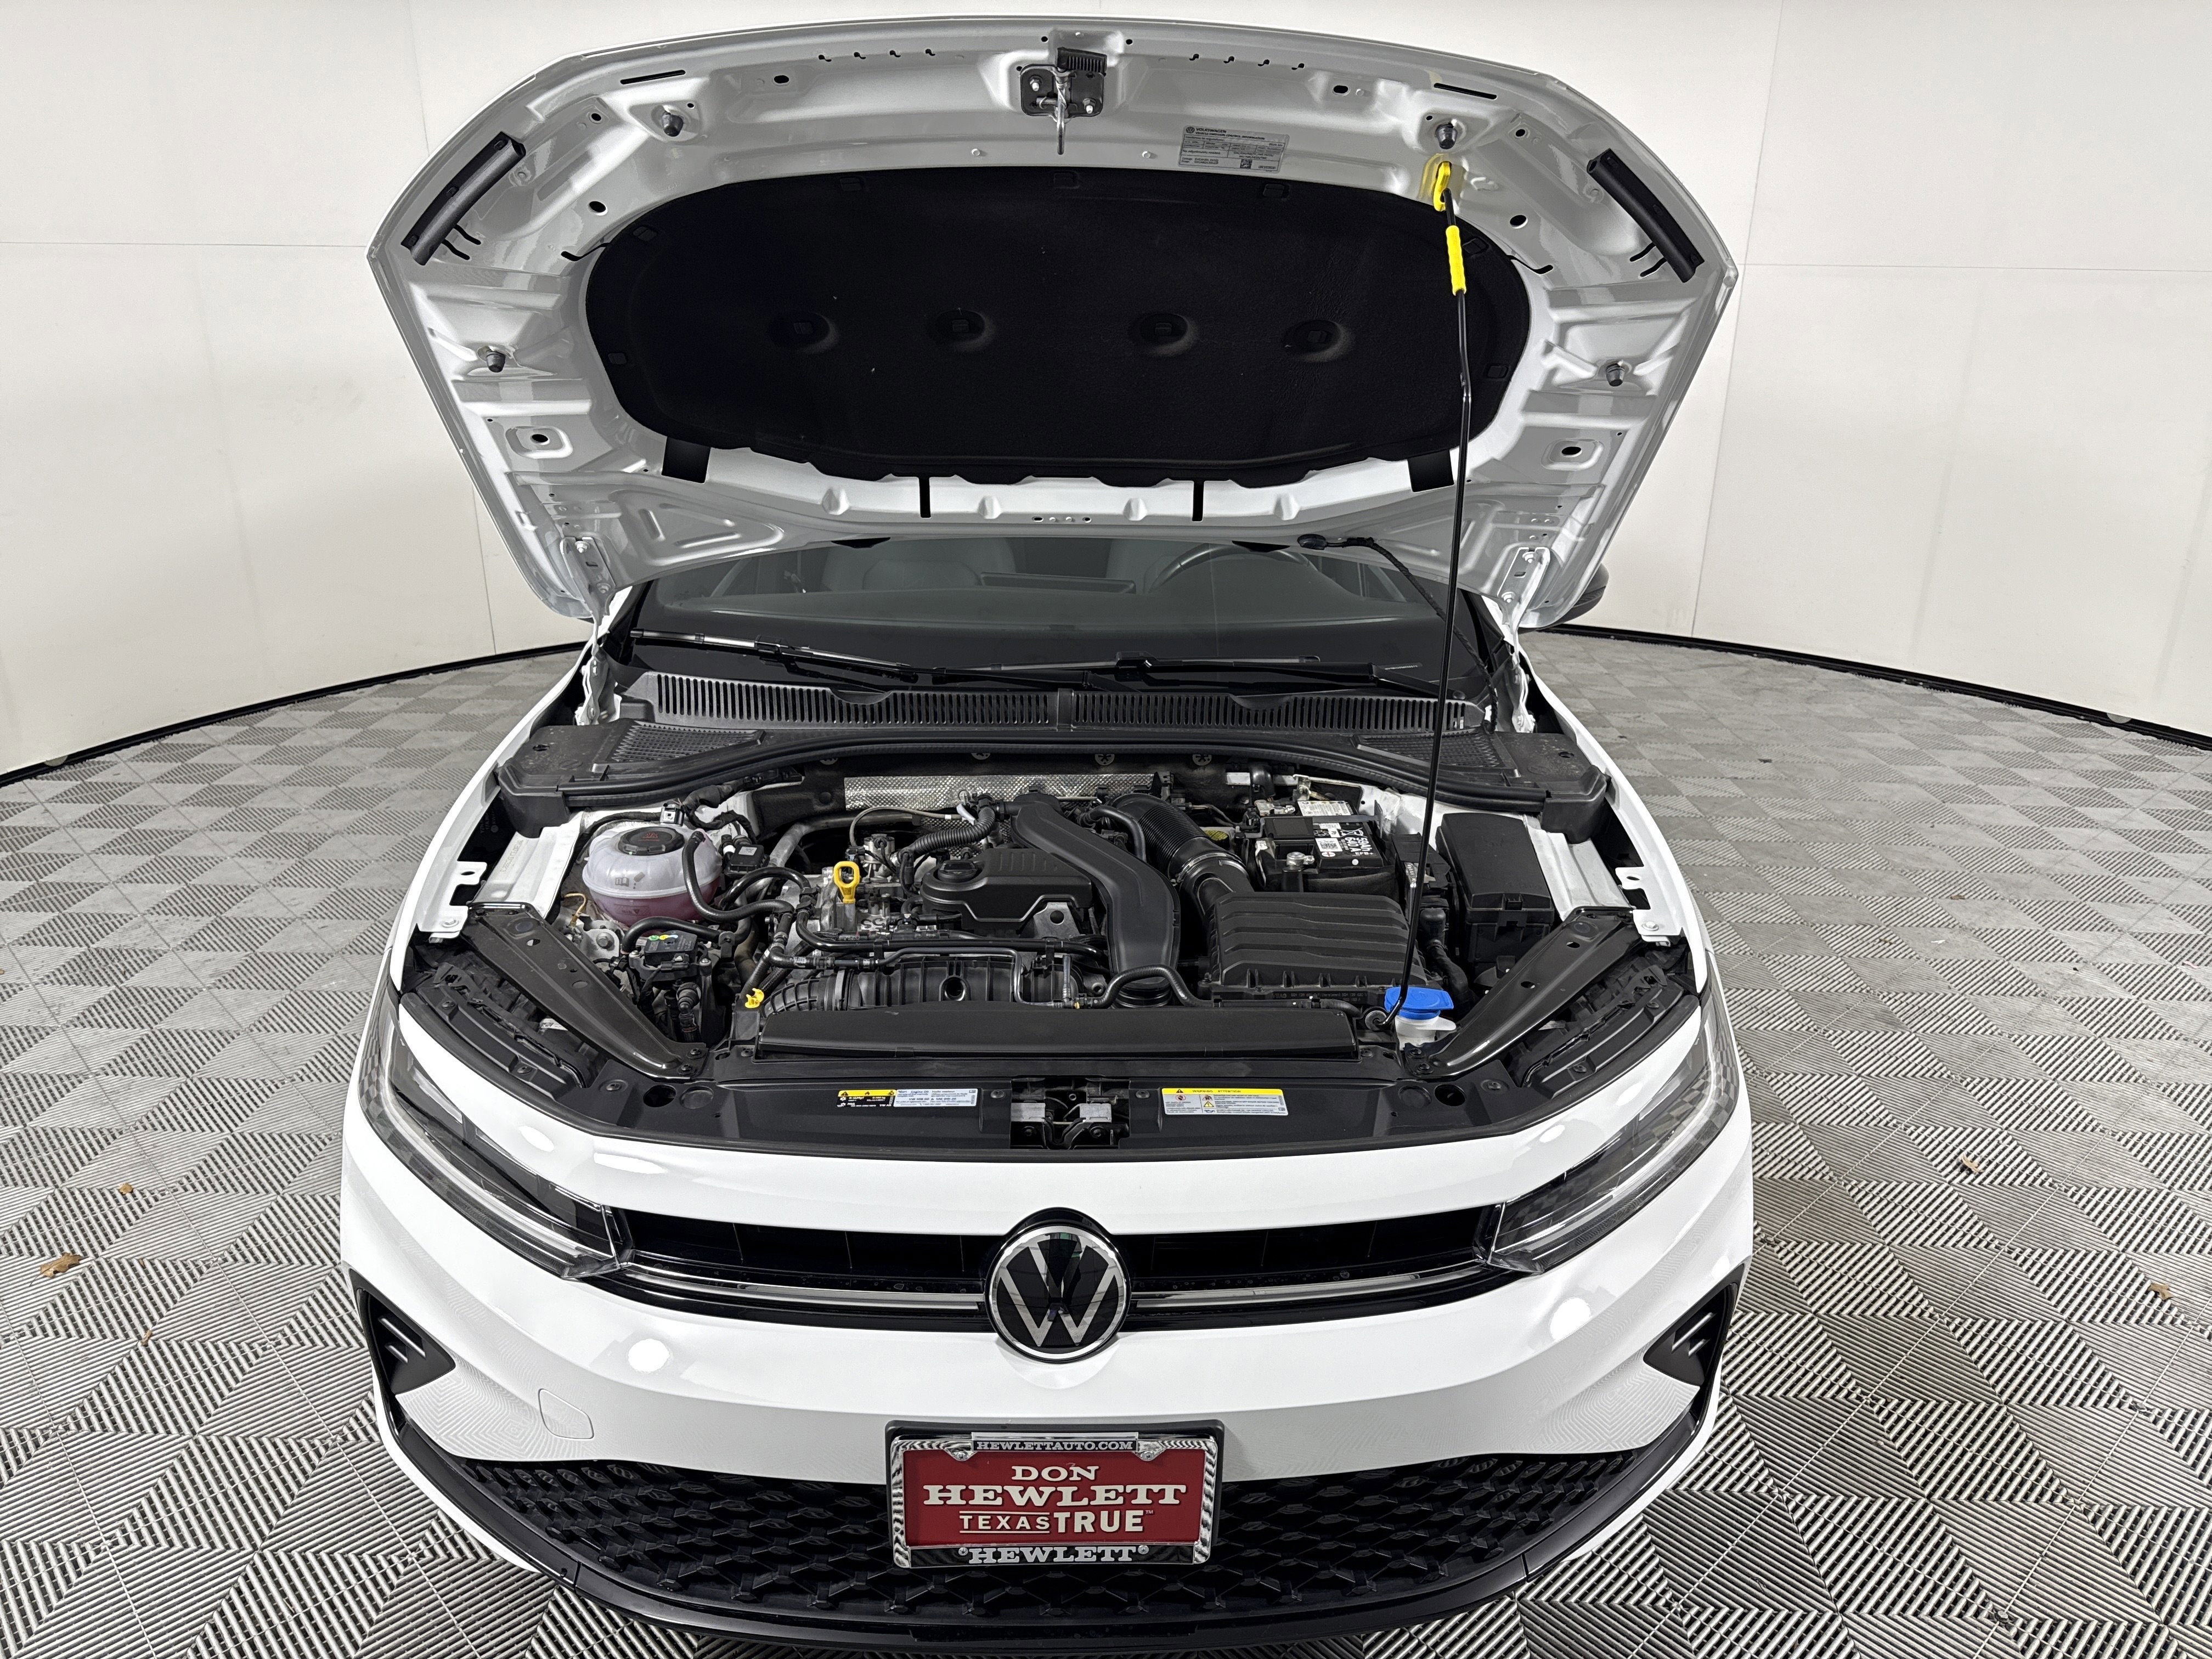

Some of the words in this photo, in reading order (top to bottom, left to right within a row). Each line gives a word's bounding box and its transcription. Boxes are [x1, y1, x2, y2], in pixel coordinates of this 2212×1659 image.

[1356, 837, 1373, 851] 59Ah
[976, 1441, 1133, 1451] HEWLETTAUTO.COM
[1011, 1465, 1099, 1482] DON
[923, 1485, 1187, 1506] HEWLETT
[968, 1545, 1137, 1564] HEWLETT
